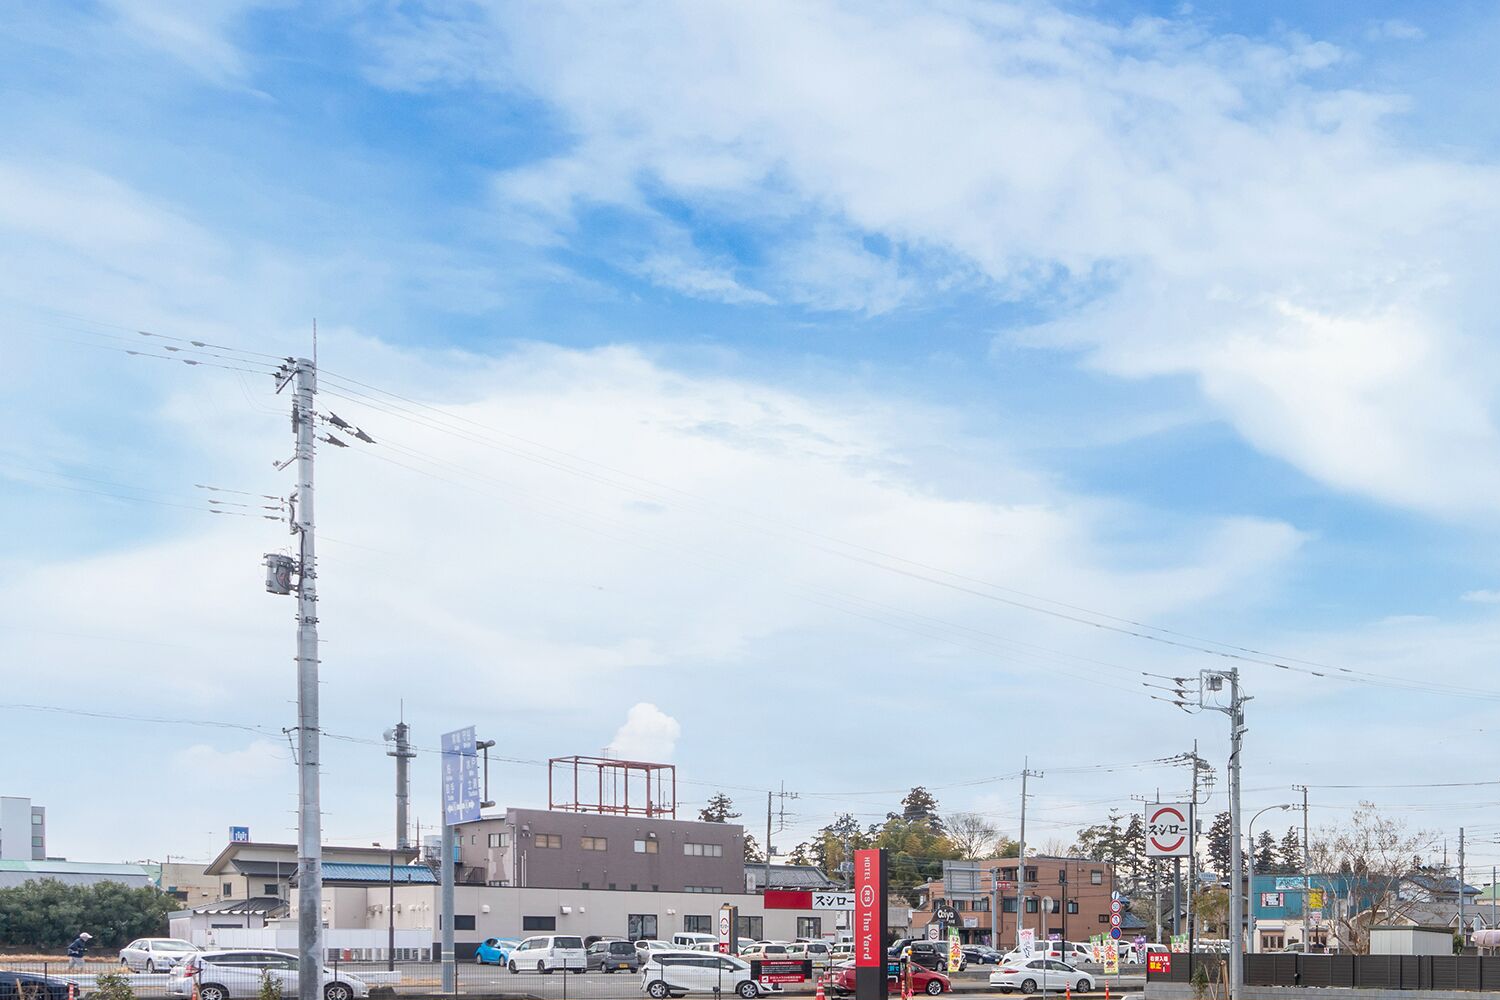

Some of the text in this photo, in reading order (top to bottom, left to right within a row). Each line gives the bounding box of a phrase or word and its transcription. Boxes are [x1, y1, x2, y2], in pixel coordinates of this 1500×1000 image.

[1147, 824, 1188, 836] スシロー
[863, 856, 871, 881] HOTEL
[815, 895, 855, 907] スシロー
[863, 911, 872, 931] The
[863, 935, 872, 960] Yard
